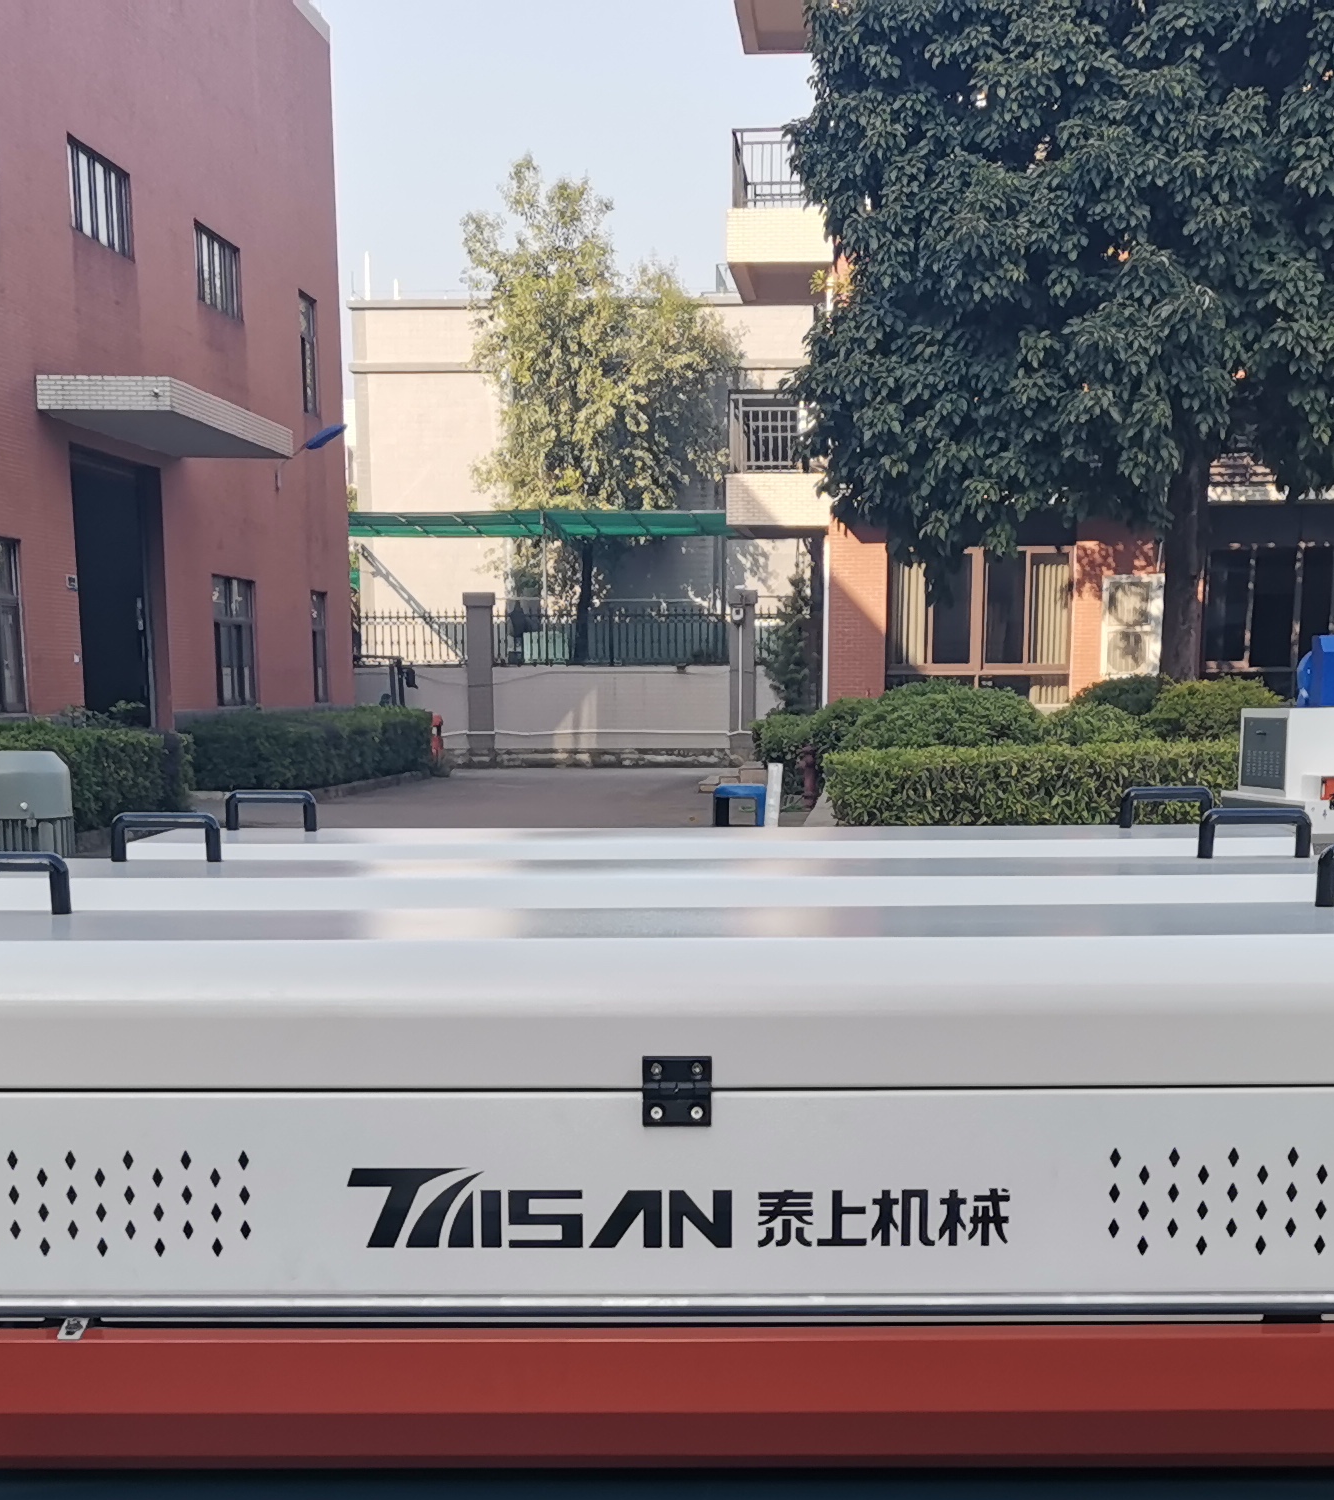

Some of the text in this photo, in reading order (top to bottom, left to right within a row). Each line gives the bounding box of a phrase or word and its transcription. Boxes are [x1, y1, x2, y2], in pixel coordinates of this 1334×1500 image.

[347, 1167, 1011, 1248] TAISAN 泰上机械
